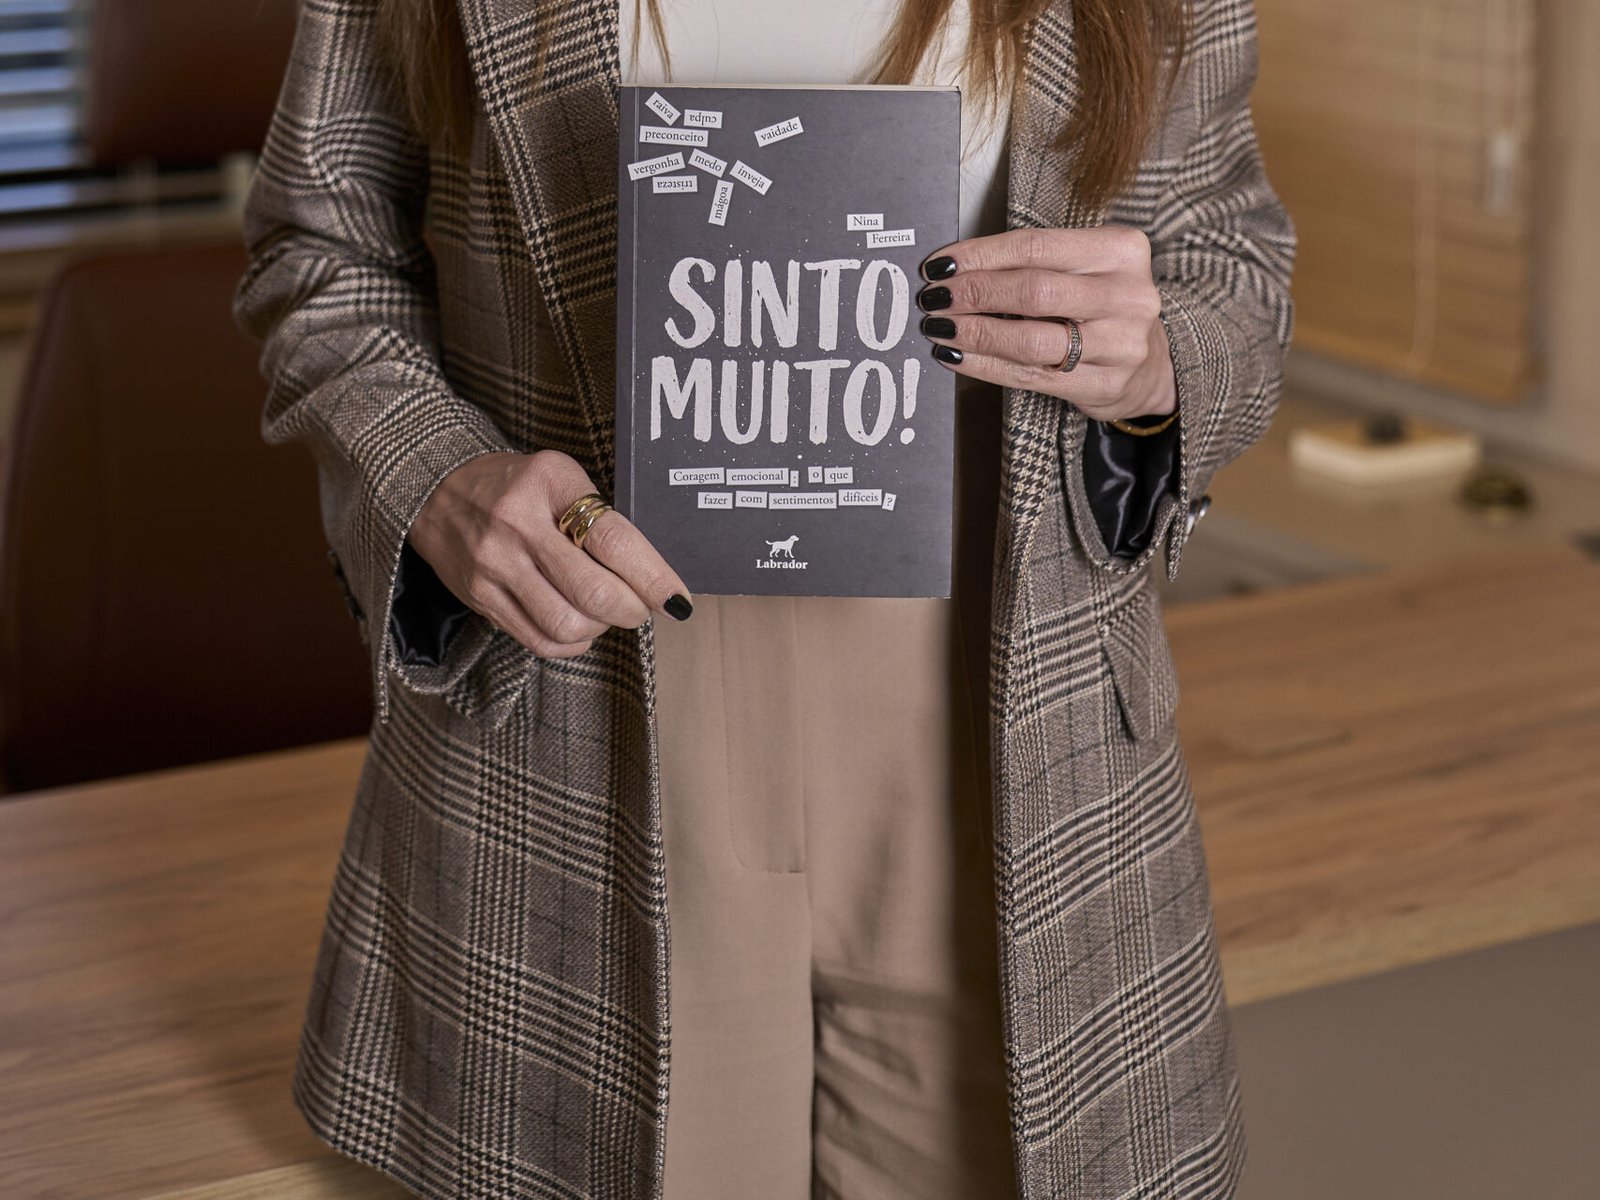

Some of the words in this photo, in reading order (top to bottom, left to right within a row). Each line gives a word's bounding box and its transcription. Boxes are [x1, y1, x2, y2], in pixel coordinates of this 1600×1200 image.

[652, 98, 675, 120] raiva
[689, 112, 717, 125] culpa
[644, 129, 704, 143] preconceito
[760, 121, 799, 141] vaidade
[633, 157, 680, 176] vergonha
[694, 154, 722, 172] medo
[656, 179, 693, 191] tristeza
[737, 165, 766, 190] inveja
[714, 186, 729, 219] mágoa
[853, 215, 879, 227] Nina
[871, 231, 911, 244] Ferreira
[664, 256, 909, 352] SINTO
[650, 355, 921, 446] MUITO!
[673, 471, 720, 484] Coragem
[812, 471, 820, 479] o
[829, 471, 849, 482] que
[703, 494, 728, 506] fazer
[740, 495, 763, 504] com
[772, 494, 834, 505] sentimentos
[755, 559, 808, 570] Labrador
